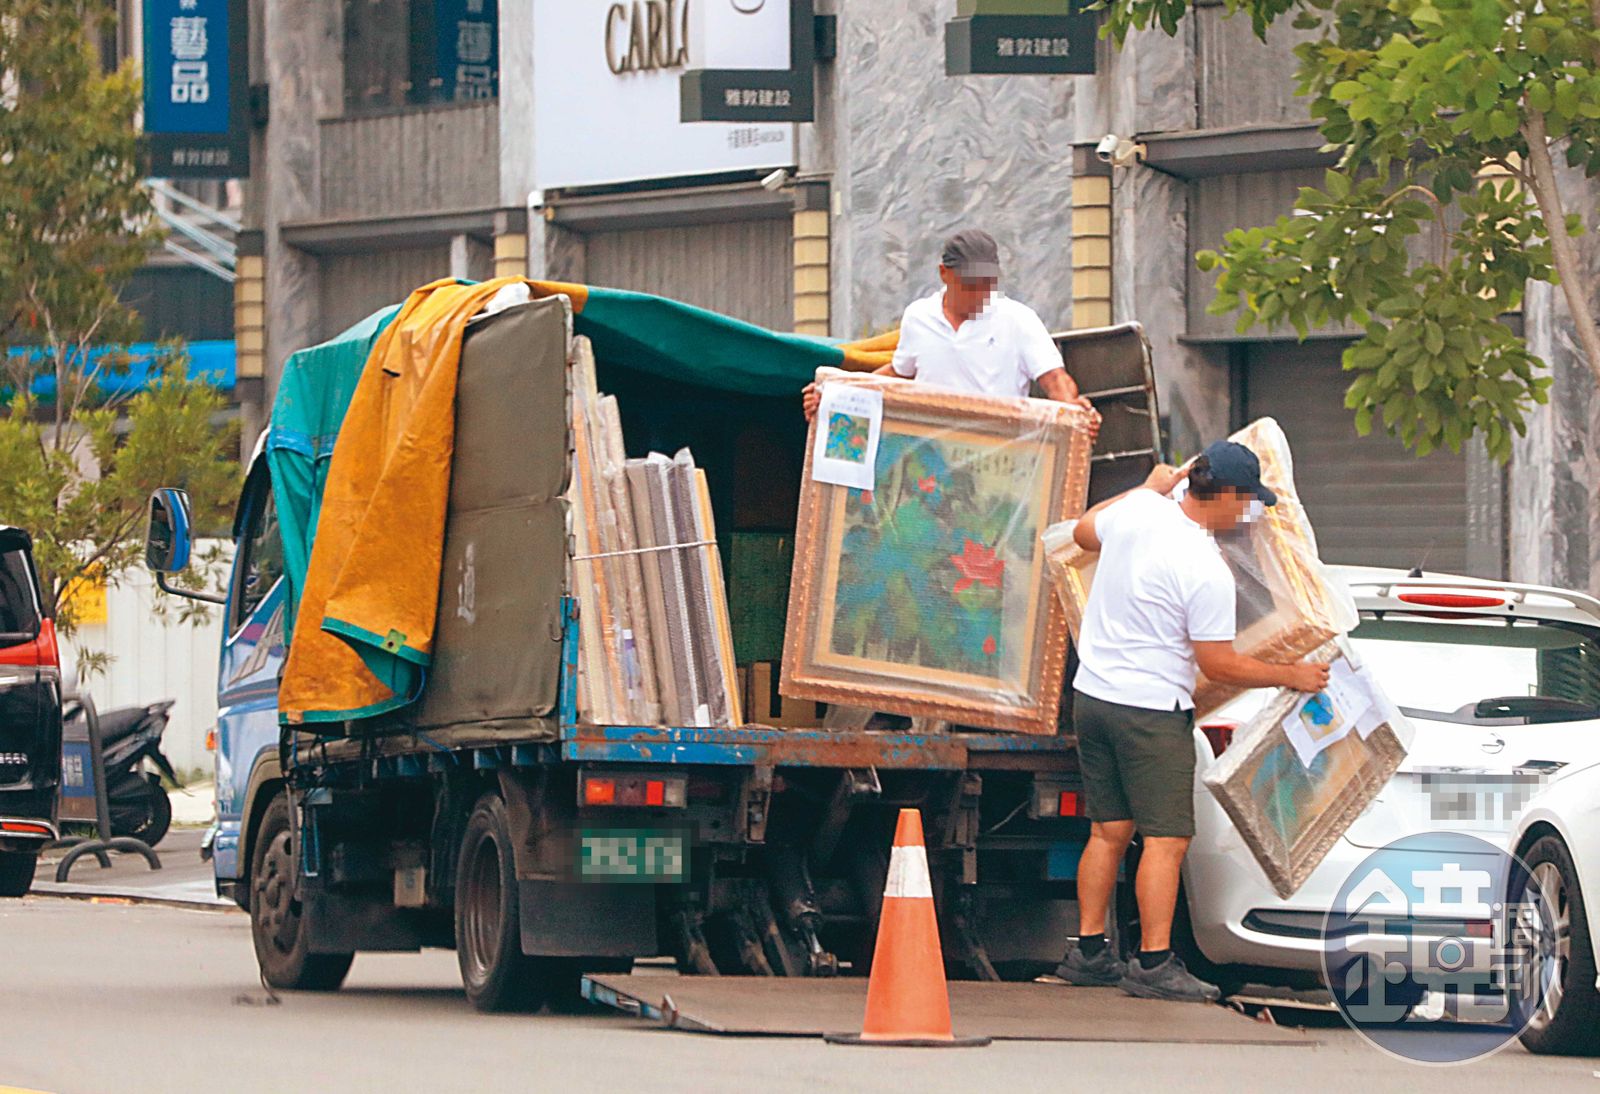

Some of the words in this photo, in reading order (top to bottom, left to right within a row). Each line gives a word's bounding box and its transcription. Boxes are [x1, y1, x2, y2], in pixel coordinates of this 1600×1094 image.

[170, 0, 209, 103] 藝品
[725, 89, 791, 107] 雅敦建設
